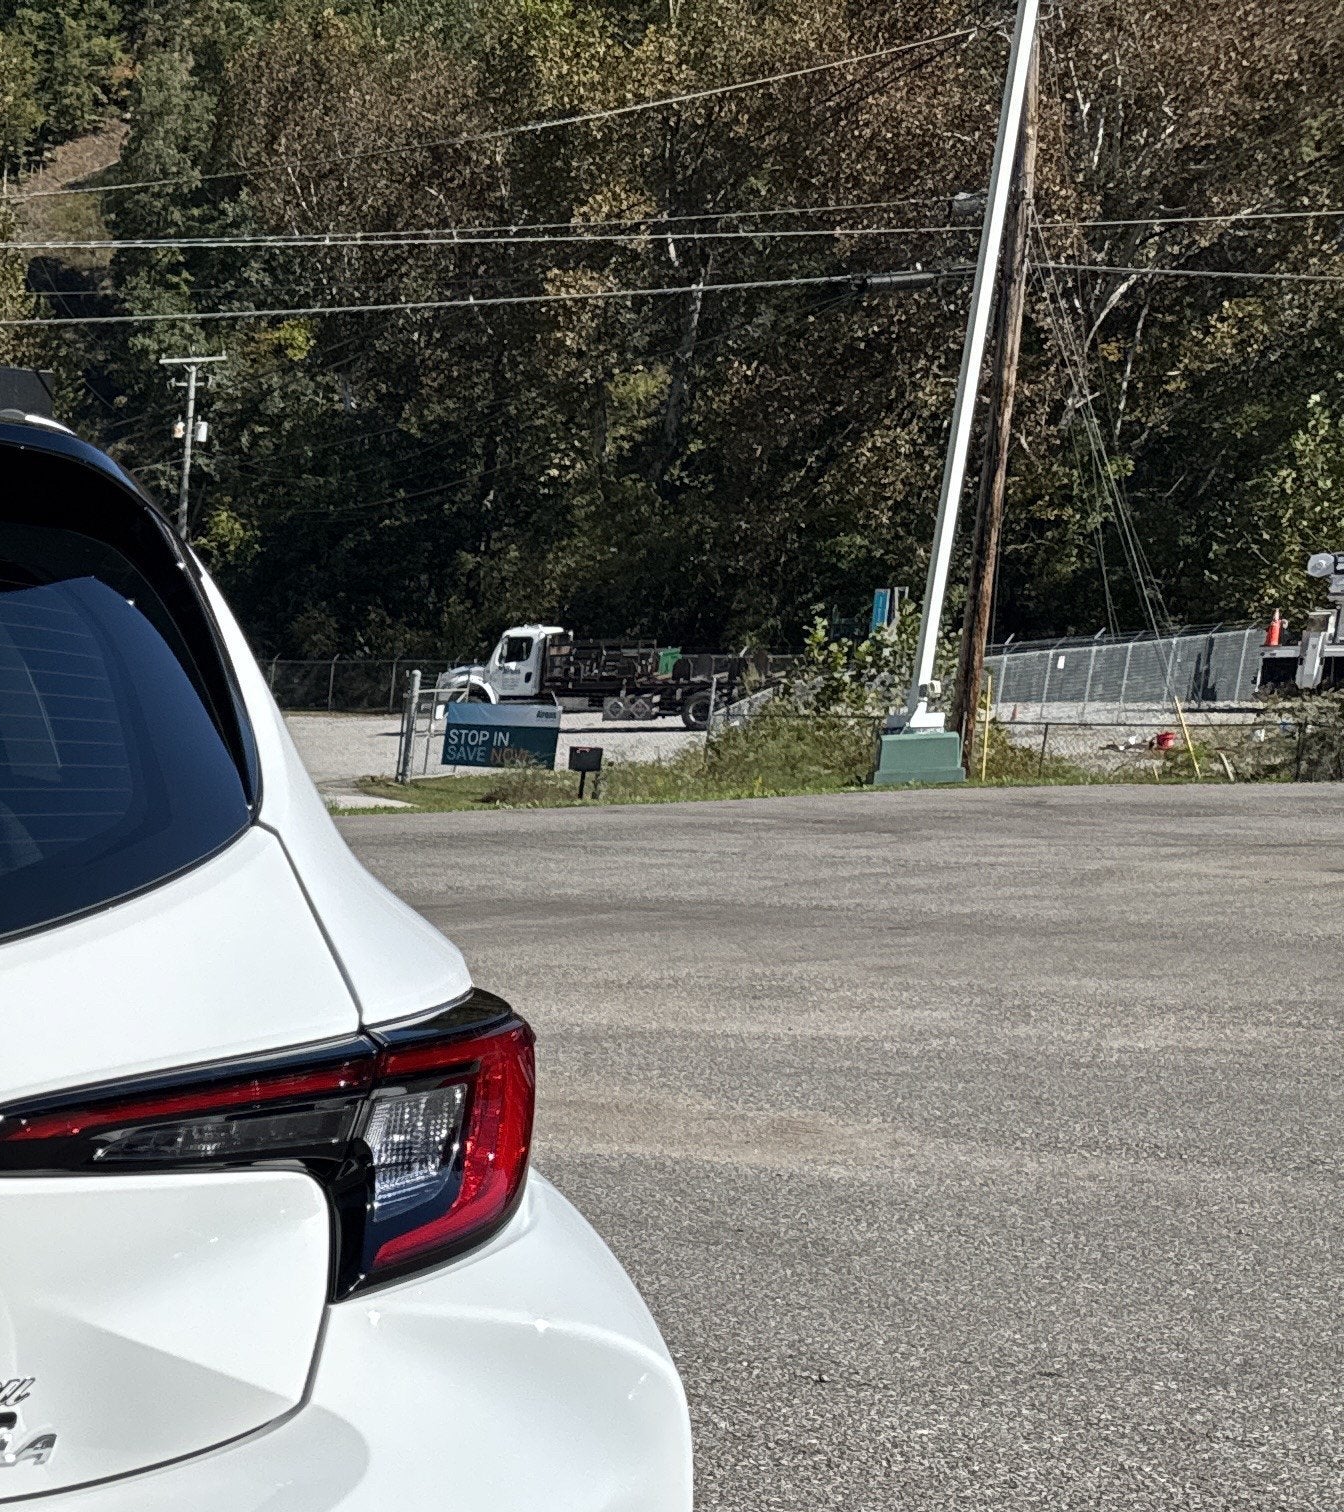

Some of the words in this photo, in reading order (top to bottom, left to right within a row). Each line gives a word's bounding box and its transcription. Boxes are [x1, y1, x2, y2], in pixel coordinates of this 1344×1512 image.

[448, 728, 490, 746] STOP
[492, 731, 510, 747] IN
[446, 745, 487, 763] SAVE
